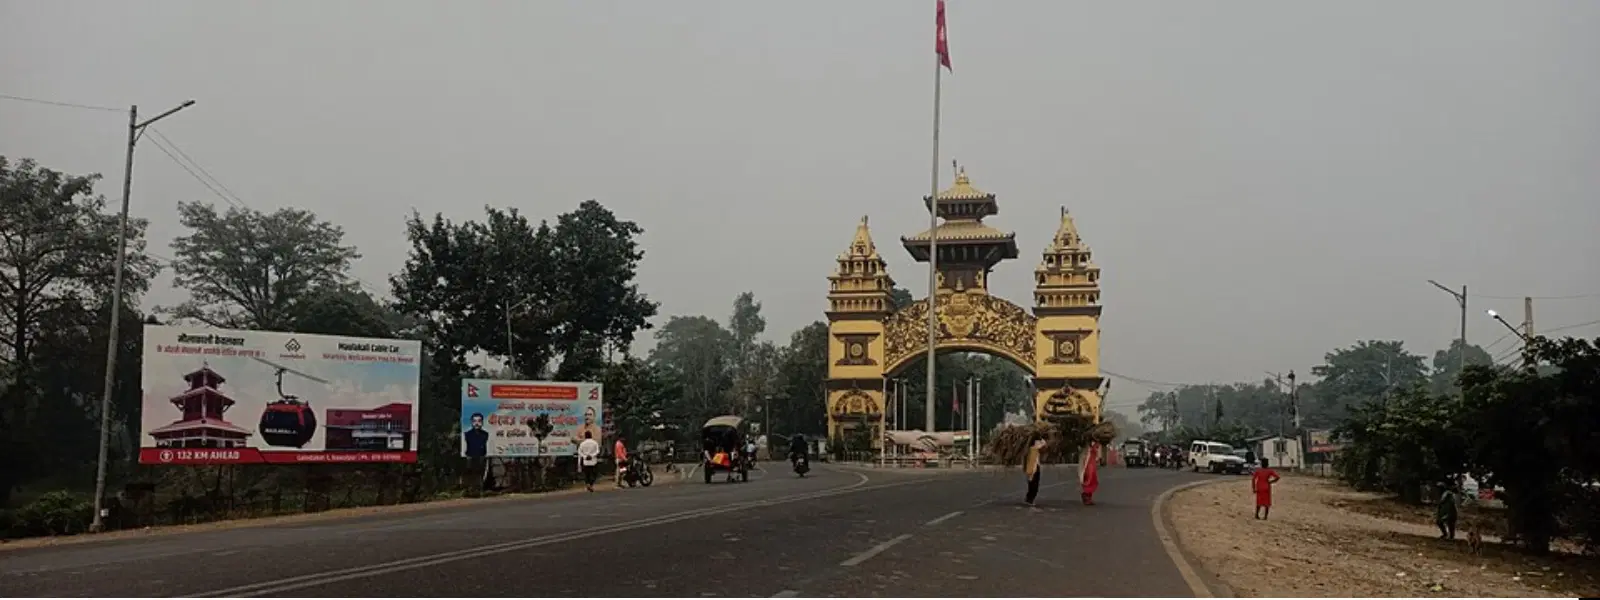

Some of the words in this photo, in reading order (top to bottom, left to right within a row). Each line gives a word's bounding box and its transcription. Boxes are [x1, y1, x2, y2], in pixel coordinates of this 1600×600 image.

[371, 344, 388, 352] Cable
[390, 345, 399, 353] Car
[177, 451, 192, 460] 132
[194, 451, 208, 460] KM
[209, 451, 240, 460] AHEAD
